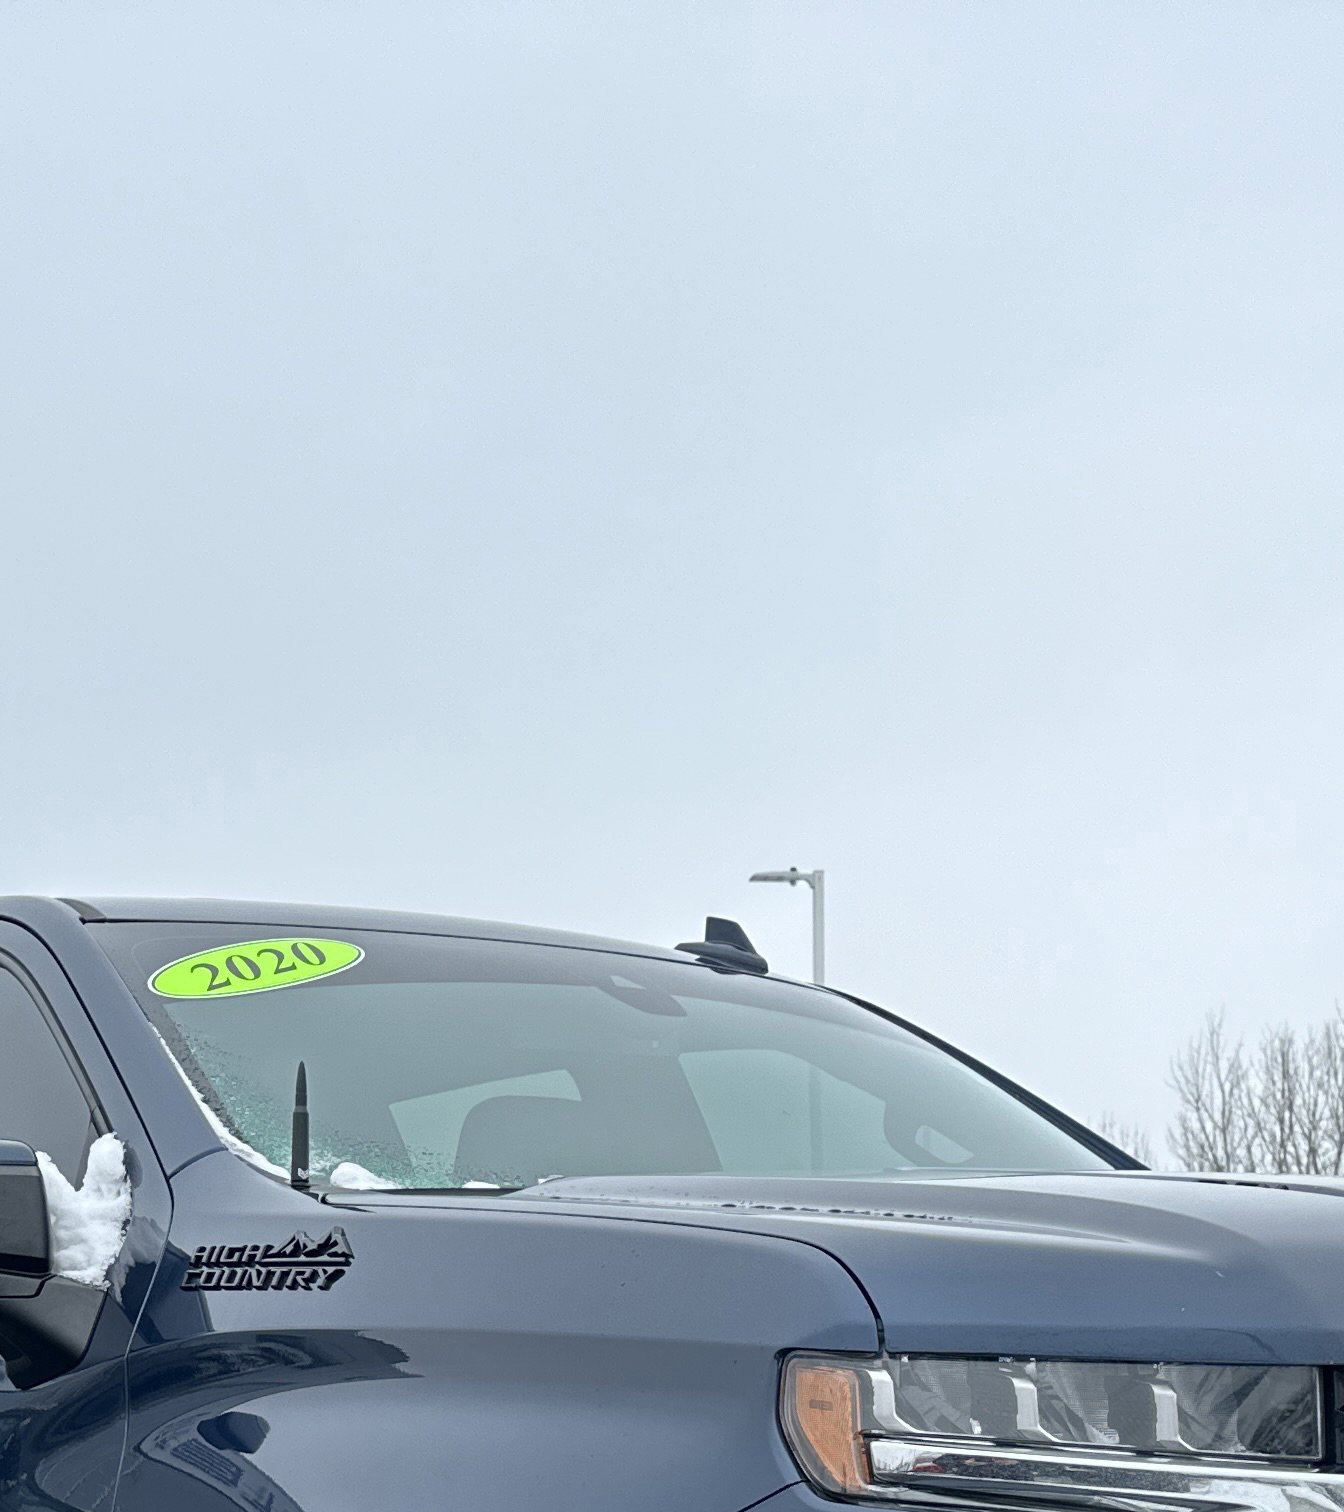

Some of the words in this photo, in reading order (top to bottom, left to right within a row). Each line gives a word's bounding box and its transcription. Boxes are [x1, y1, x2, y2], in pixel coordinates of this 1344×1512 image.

[190, 942, 327, 992] 2020
[189, 1244, 276, 1268] HIGH
[179, 1267, 346, 1291] COUNTRY
